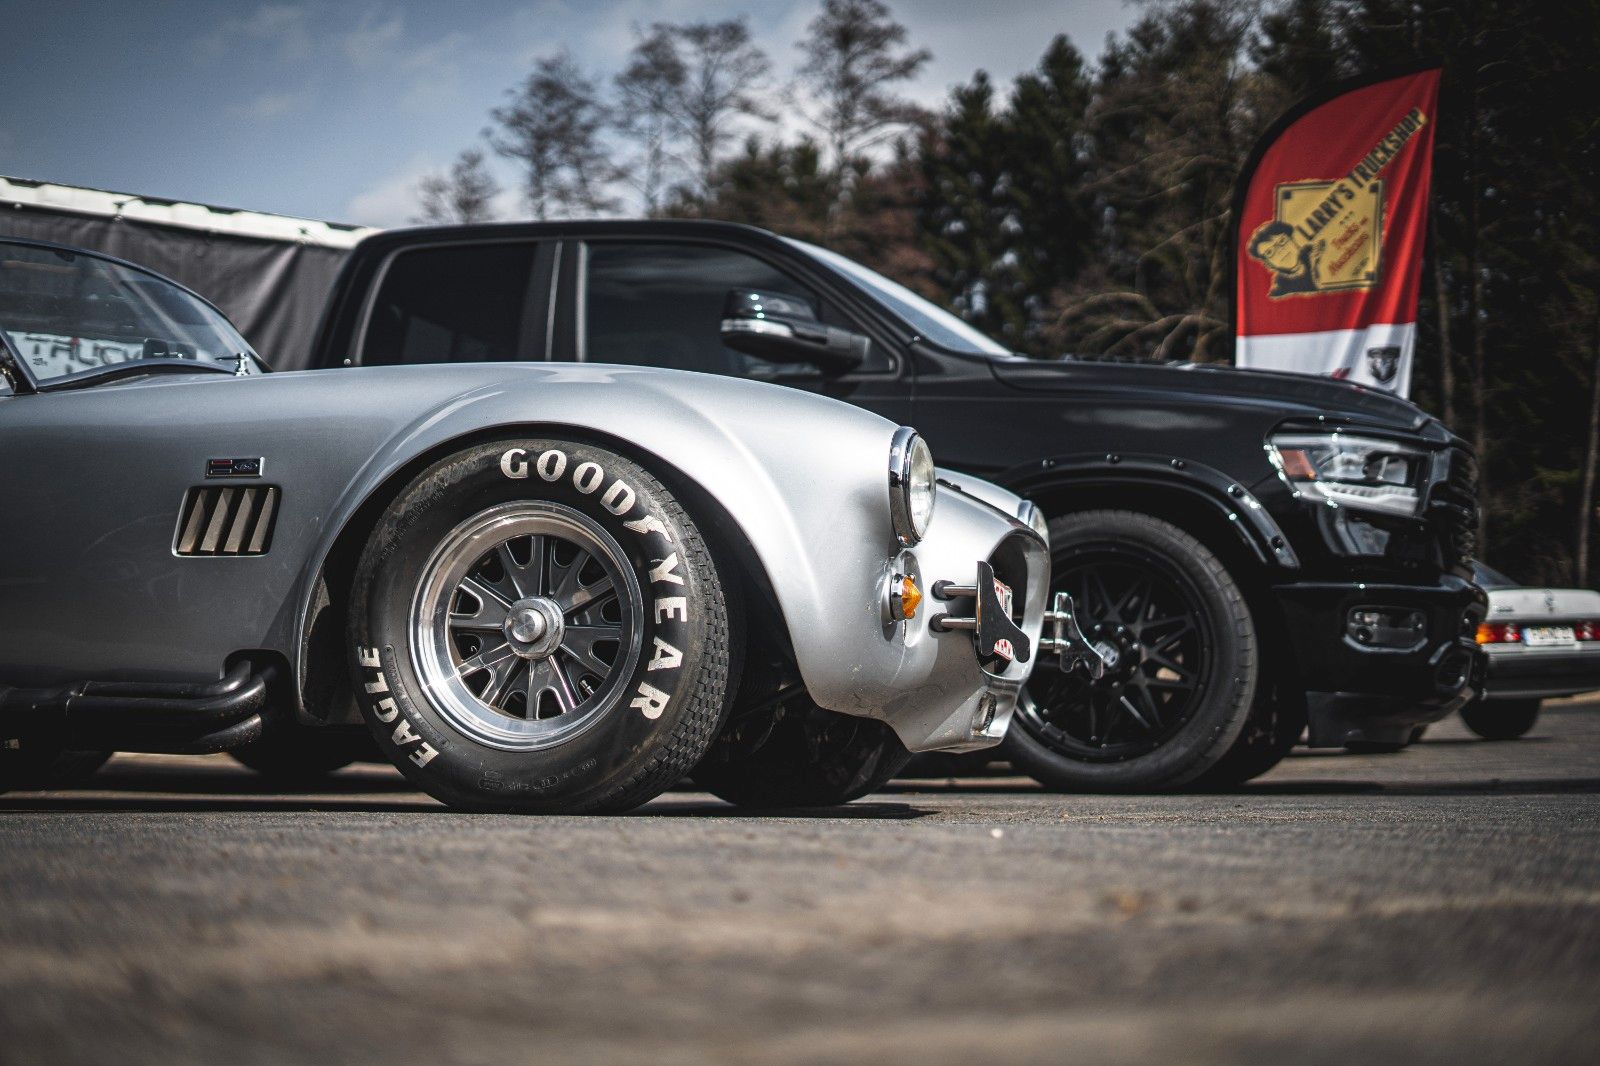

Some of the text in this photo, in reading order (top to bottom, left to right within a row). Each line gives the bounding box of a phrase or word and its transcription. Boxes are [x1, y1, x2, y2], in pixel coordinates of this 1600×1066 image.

[1298, 185, 1354, 240] LARRY'S
[1348, 107, 1423, 188] TRUCKSHOP
[357, 644, 440, 768] EAGLE
